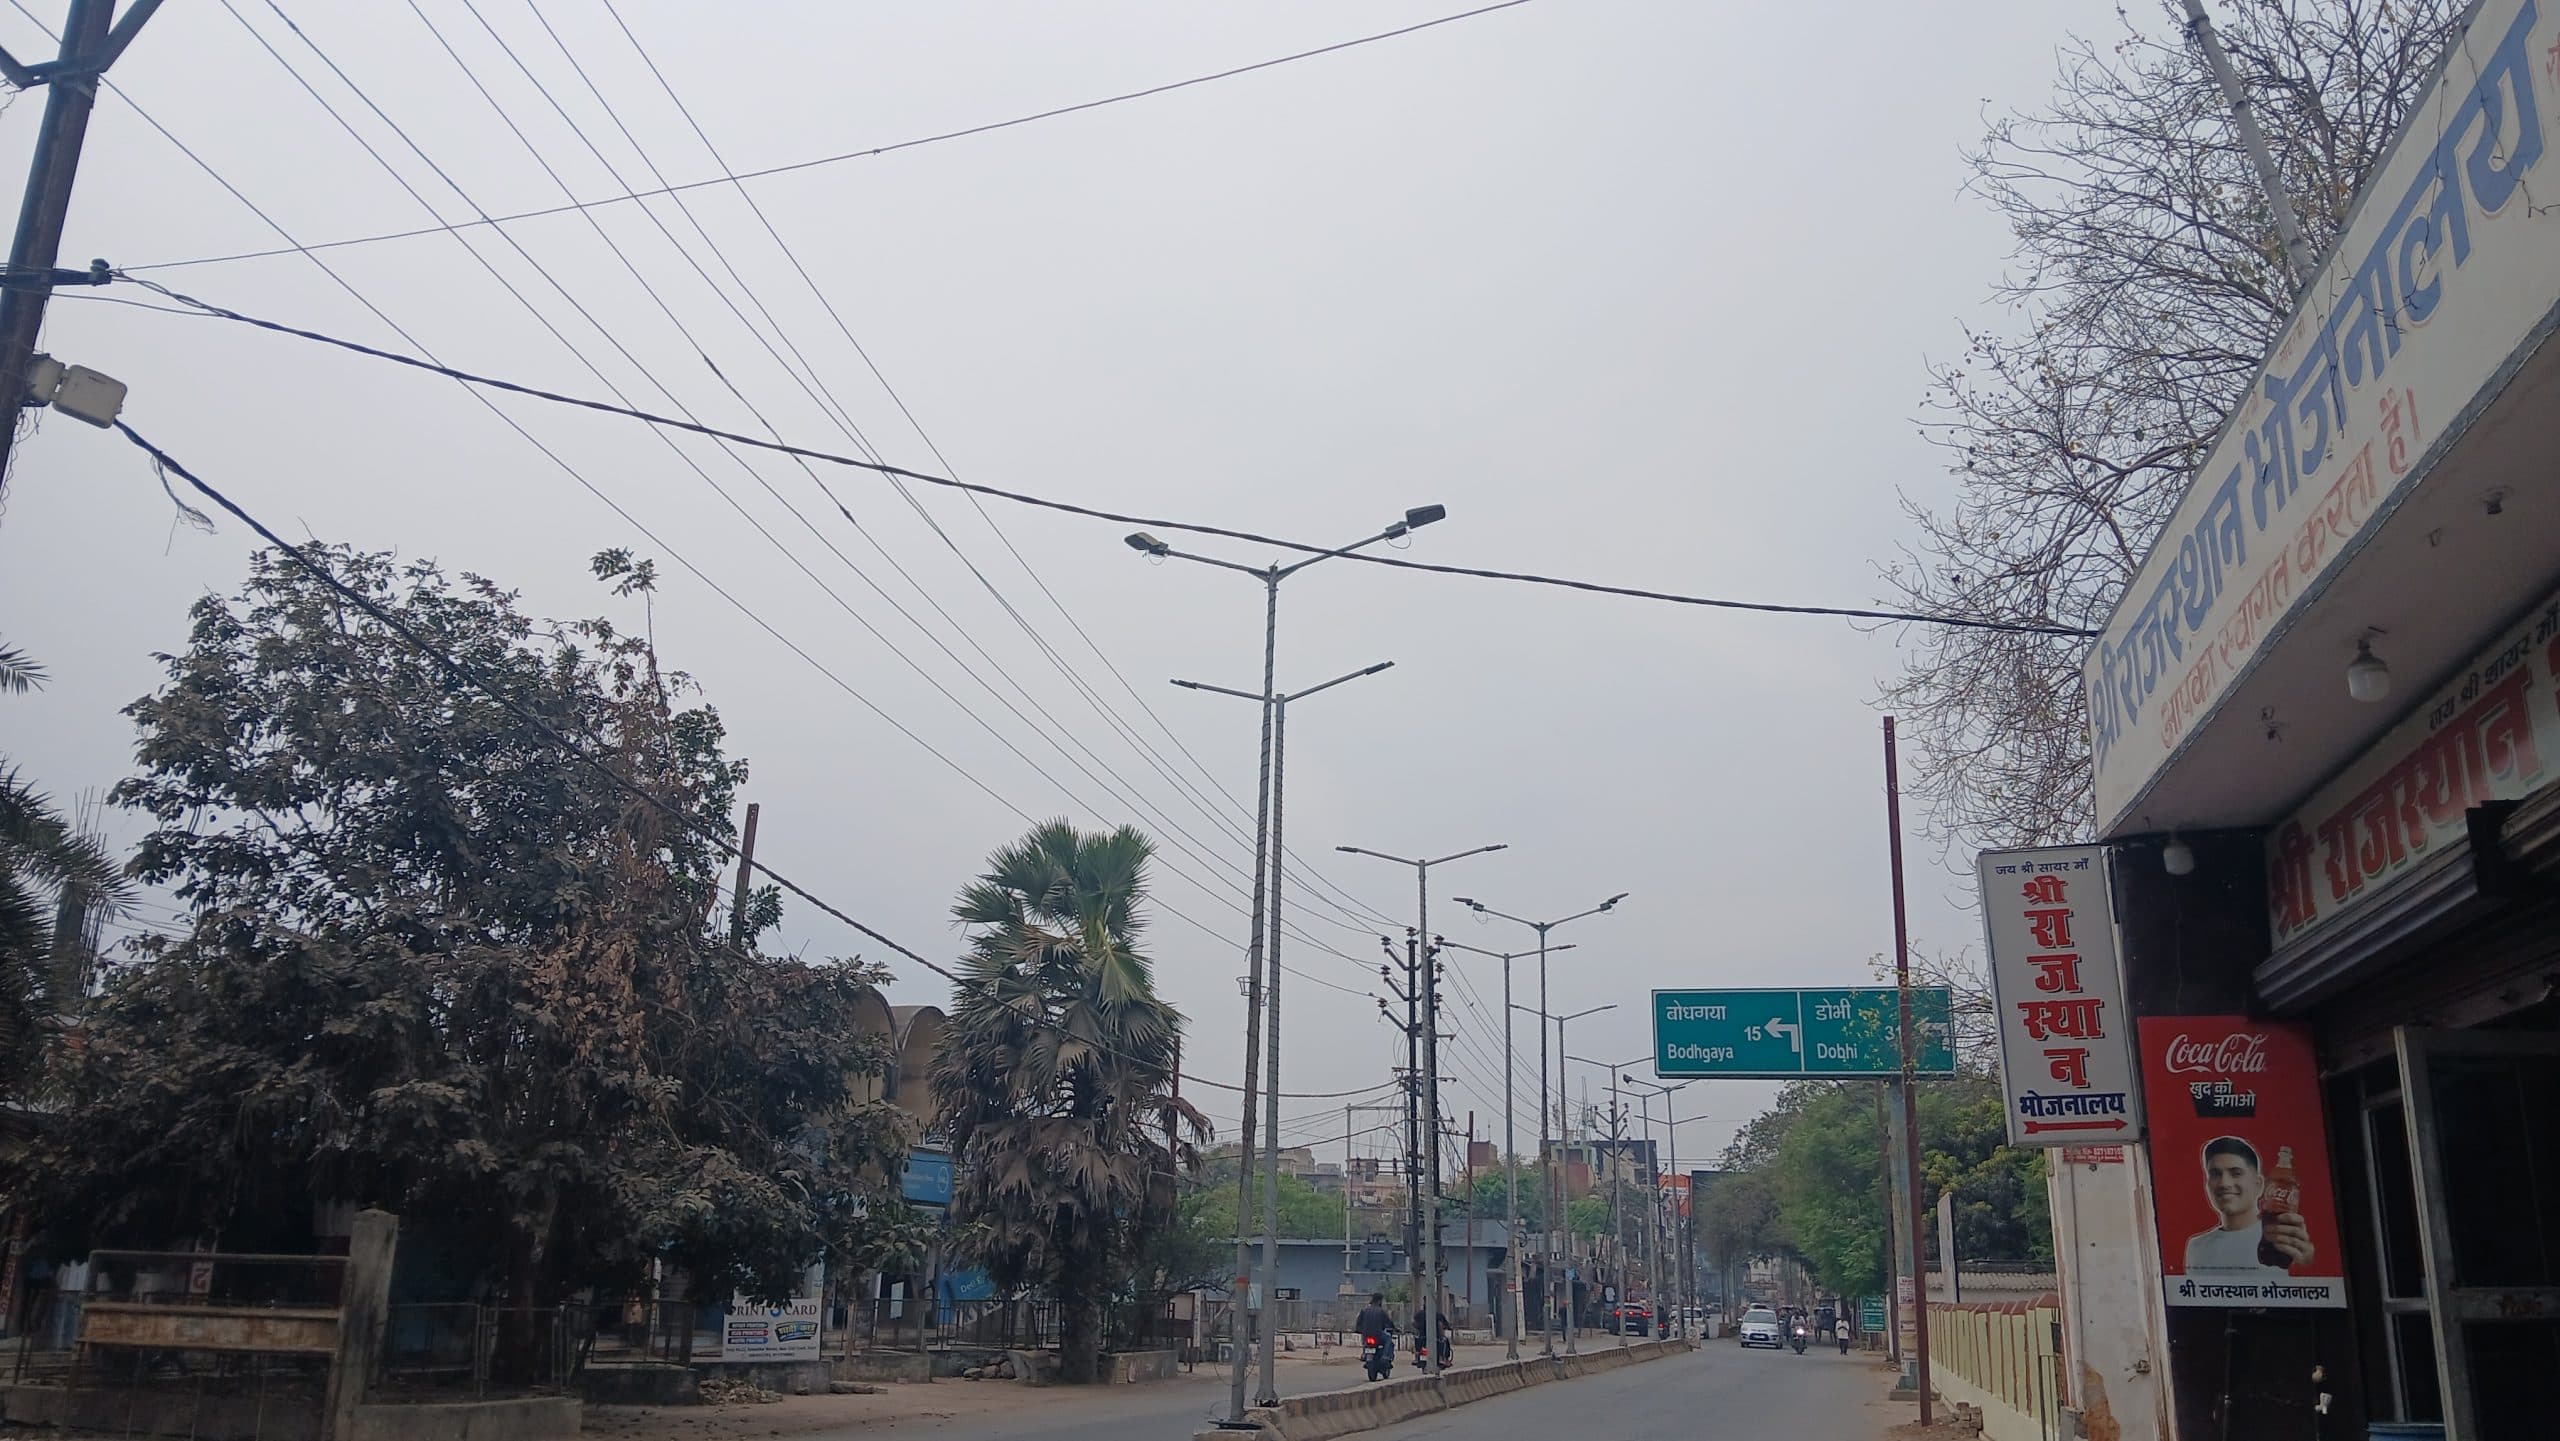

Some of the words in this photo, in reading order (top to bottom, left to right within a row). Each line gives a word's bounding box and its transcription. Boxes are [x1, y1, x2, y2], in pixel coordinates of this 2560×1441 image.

[1995, 865, 2016, 876] जय
[2021, 862, 2035, 874] श्री
[2038, 862, 2070, 873] सायर
[2073, 857, 2090, 871] माँ
[2021, 875, 2069, 905] श्री
[1666, 1000, 1726, 1021] बोधगया
[1815, 998, 1852, 1021] डोभी
[1744, 1026, 1762, 1041] 15
[1667, 1043, 1734, 1062] Bodhgaya
[1817, 1043, 1858, 1060] Dobhi
[2165, 1033, 2269, 1074] Coca-Cola
[2189, 1081, 2211, 1099] खुद
[2214, 1077, 2233, 1095] को
[2019, 1090, 2126, 1117] भोजनालय
[2213, 1090, 2257, 1108] जगाओ
[2178, 1279, 2196, 1299] श्री
[2199, 1283, 2259, 1299] राजस्थान
[2262, 1281, 2330, 1300] भोजनालय
[784, 1304, 817, 1316] CARD
